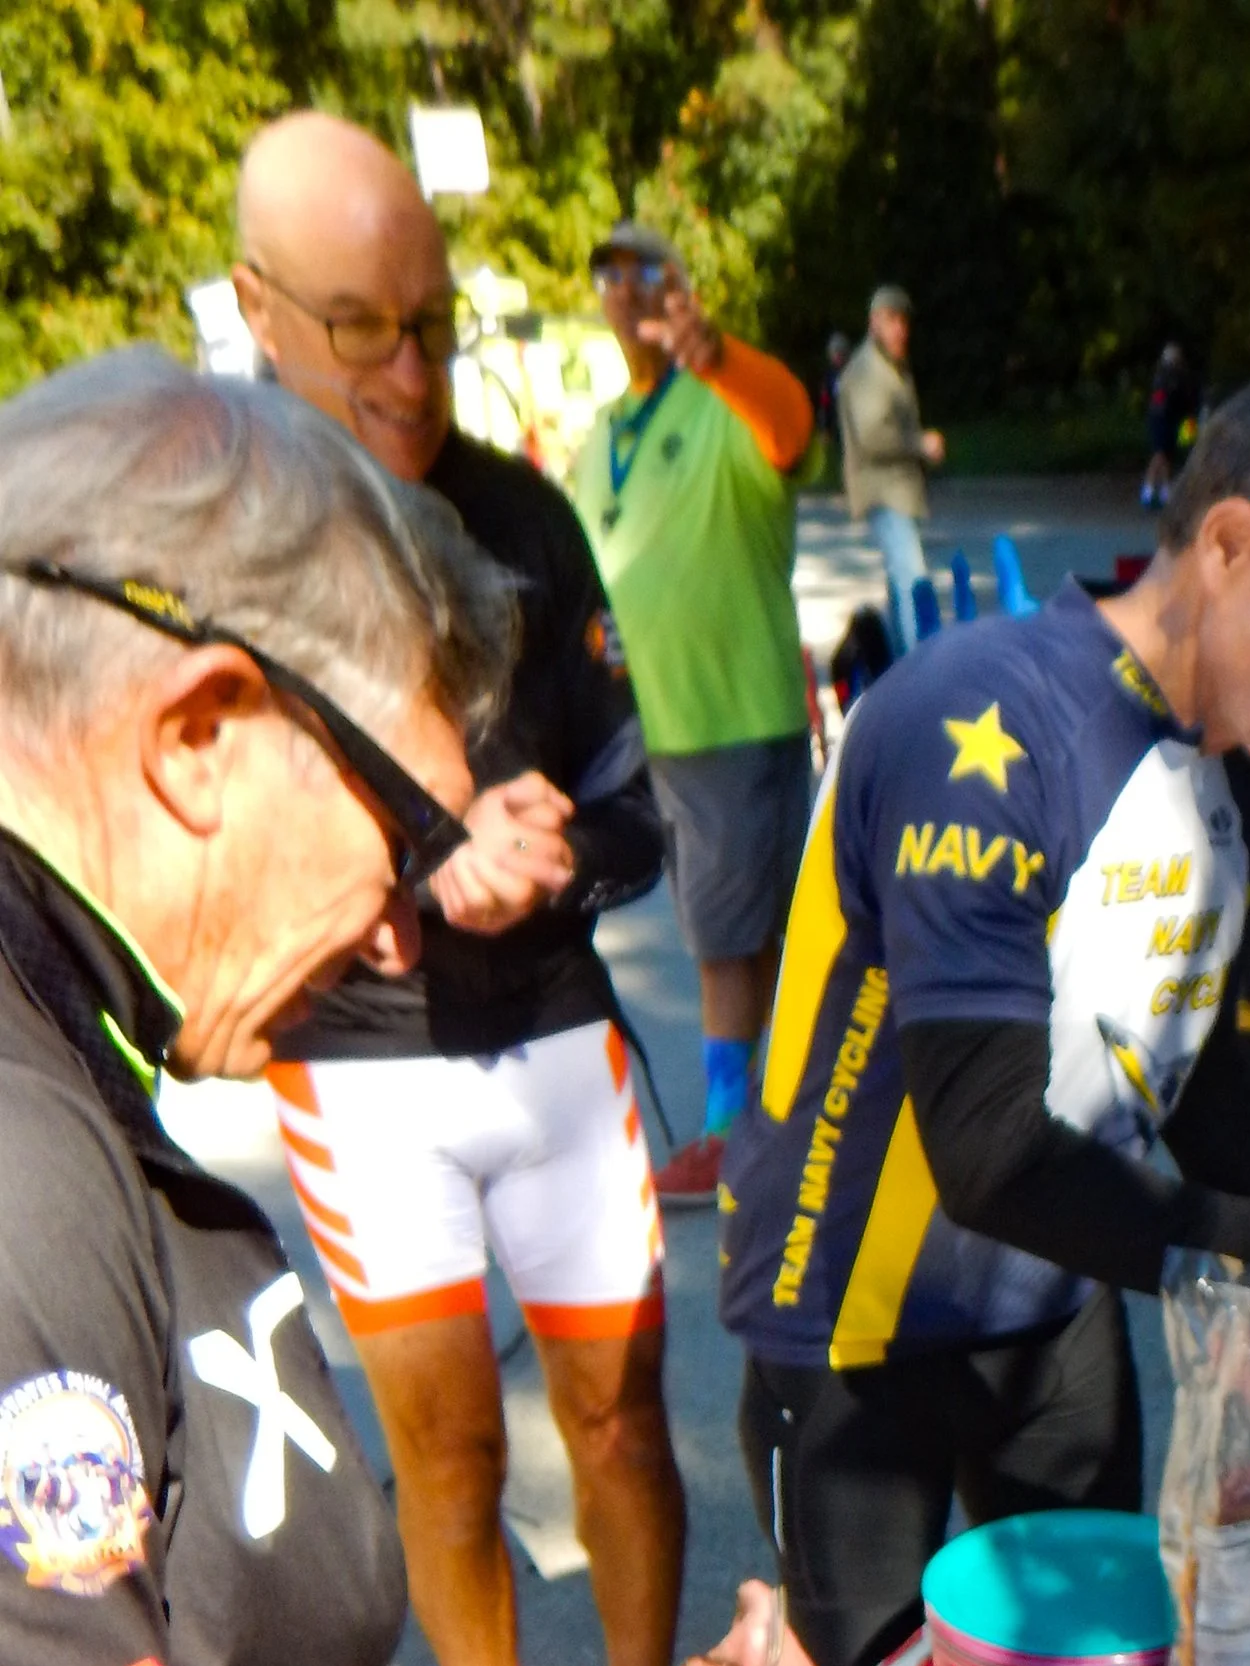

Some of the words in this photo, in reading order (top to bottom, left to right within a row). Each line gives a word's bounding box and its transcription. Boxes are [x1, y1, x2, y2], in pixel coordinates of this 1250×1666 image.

[895, 821, 1044, 893] NAVY
[1101, 851, 1193, 906] TEAM
[773, 1214, 817, 1307] TEAM
[797, 1115, 843, 1213] NAVY
[823, 966, 890, 1120] CYCLING
